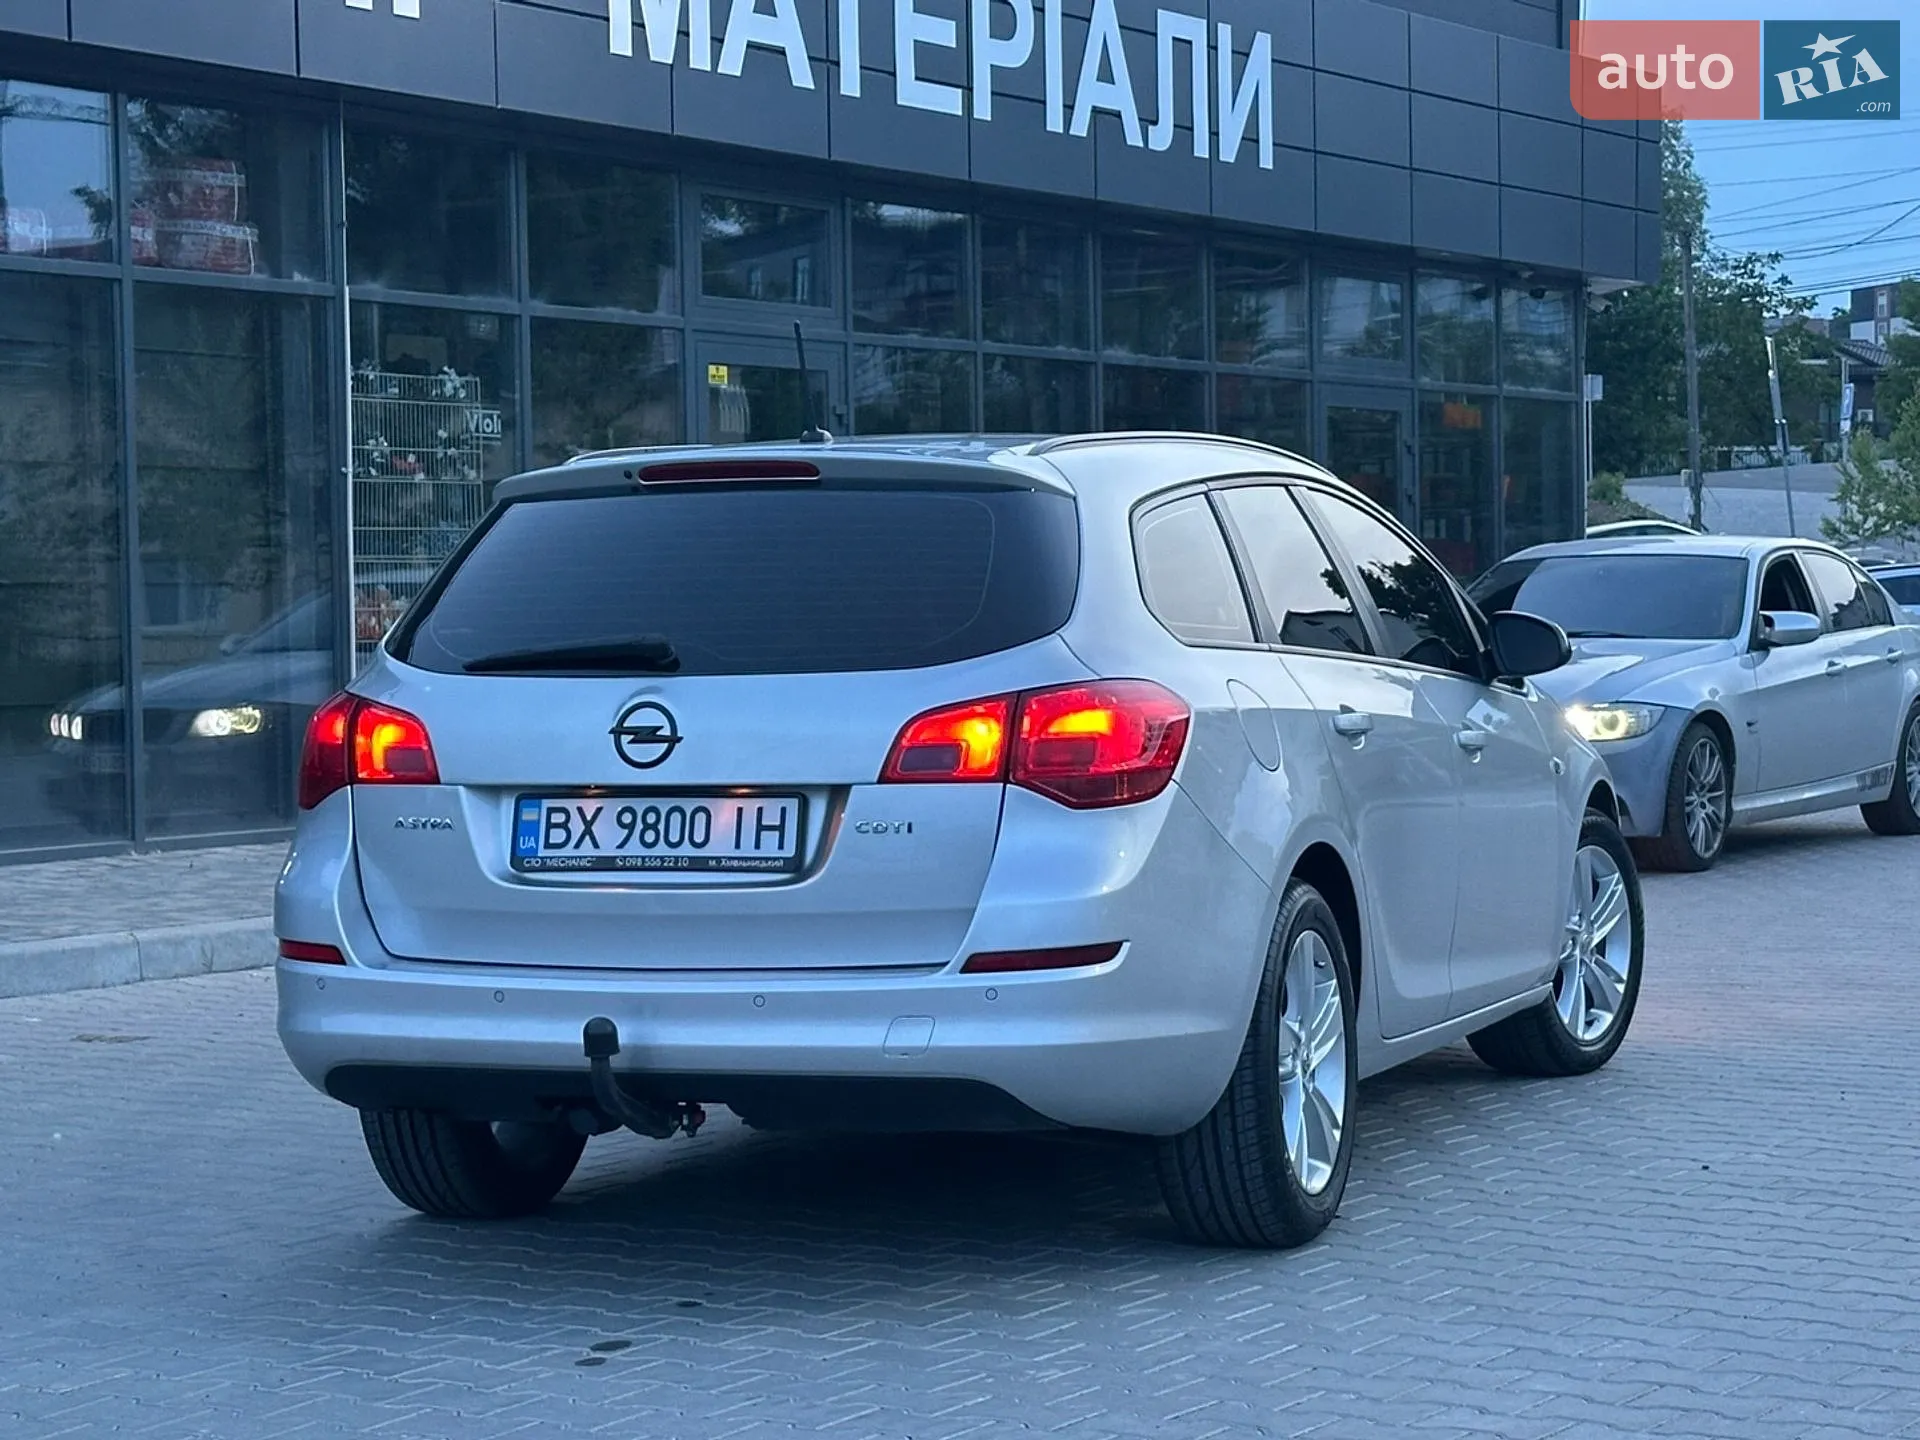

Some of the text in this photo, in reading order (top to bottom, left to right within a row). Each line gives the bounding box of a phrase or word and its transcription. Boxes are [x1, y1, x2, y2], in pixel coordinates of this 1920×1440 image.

[393, 816, 454, 830] ASTRA
[543, 805, 788, 851] BX 9800 IH
[855, 820, 913, 835] CDTI
[519, 836, 537, 850] UA
[663, 857, 676, 868] 22
[678, 857, 690, 868] 10
